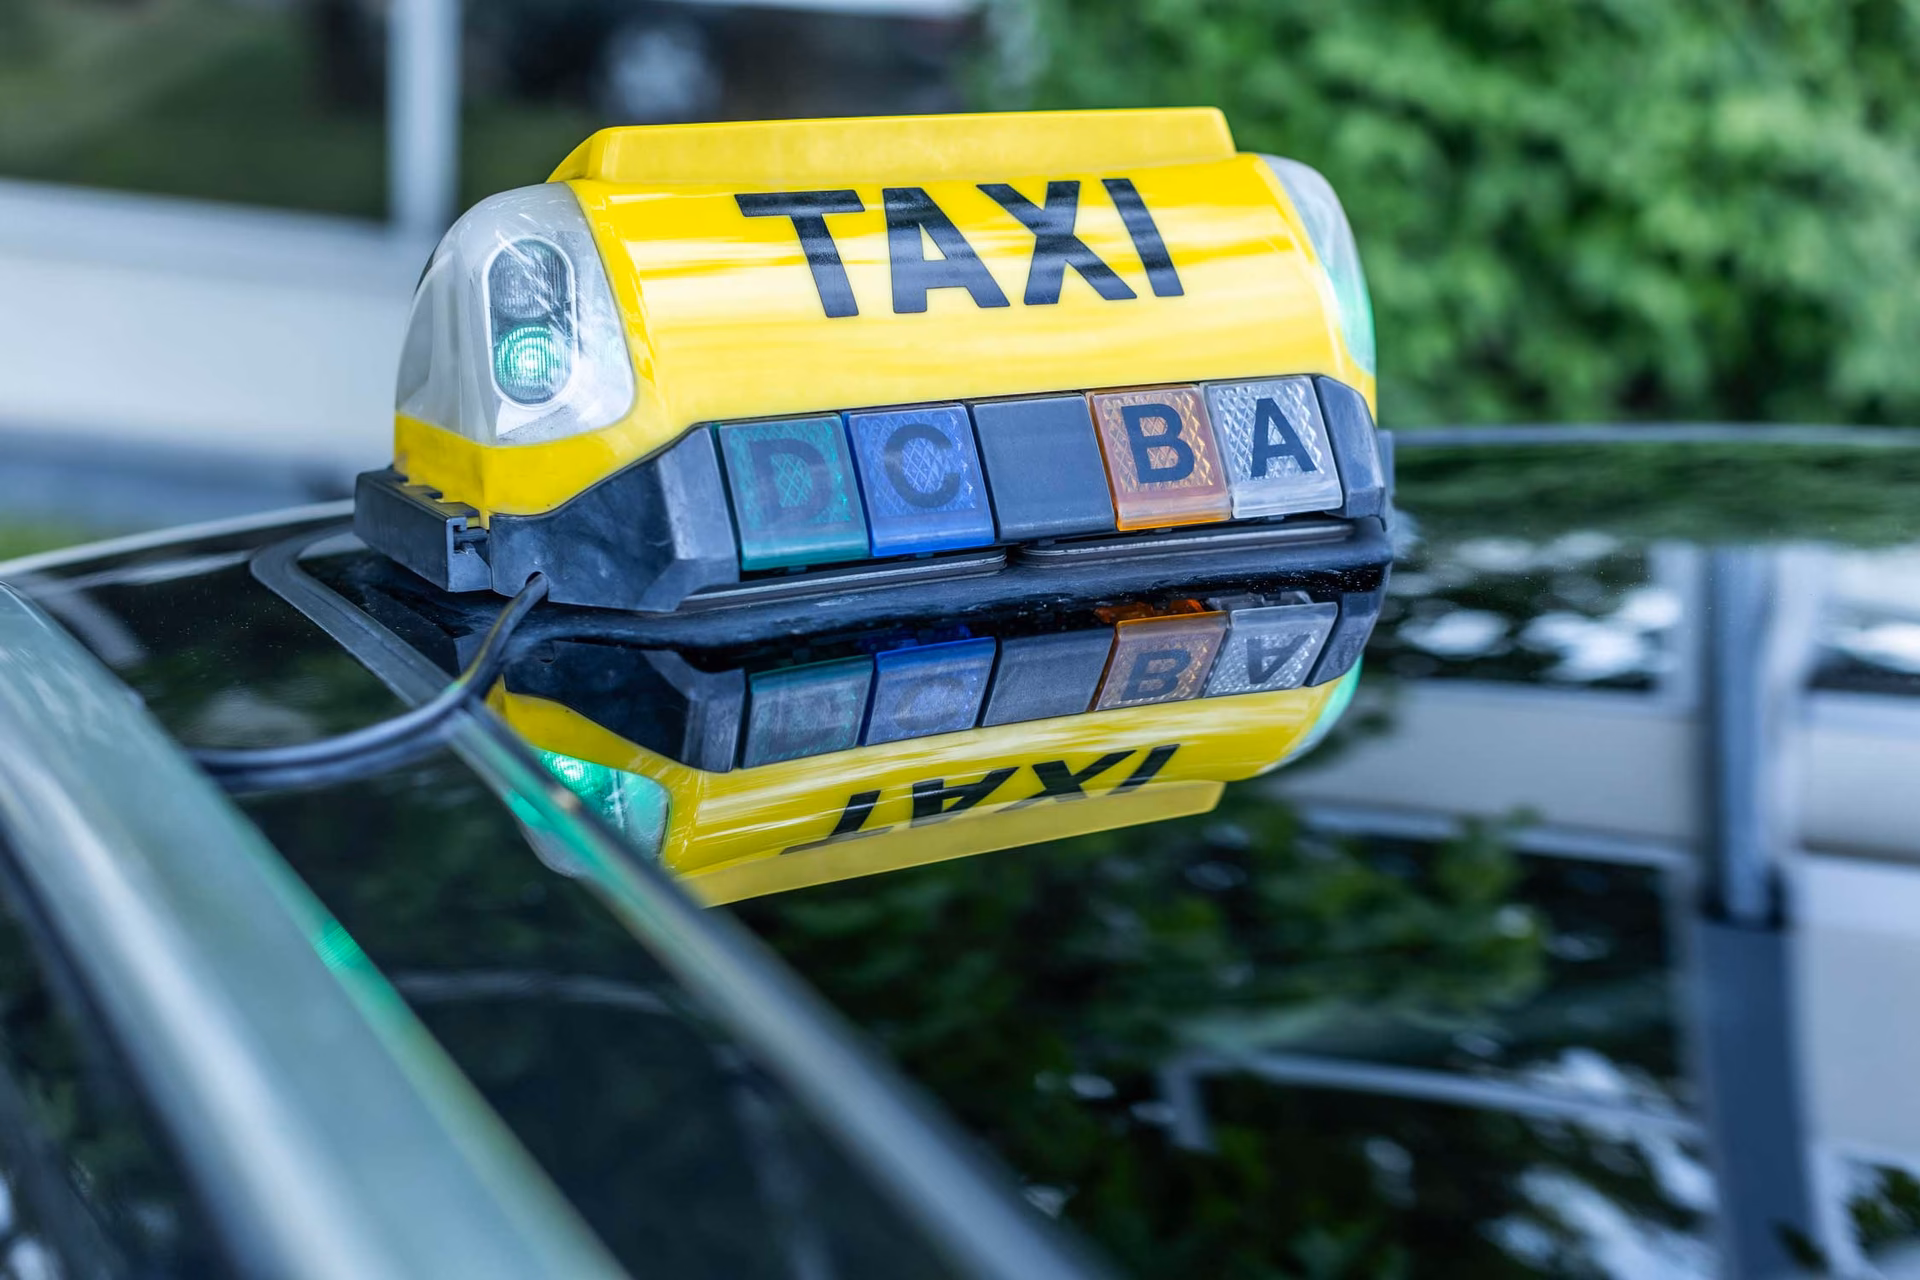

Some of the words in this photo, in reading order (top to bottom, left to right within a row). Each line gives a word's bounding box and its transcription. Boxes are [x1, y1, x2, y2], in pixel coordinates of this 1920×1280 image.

[734, 178, 1184, 318] TAXI
[748, 438, 833, 524] D
[884, 423, 961, 508] C
[1121, 403, 1196, 484] B
[1250, 398, 1317, 478] A
